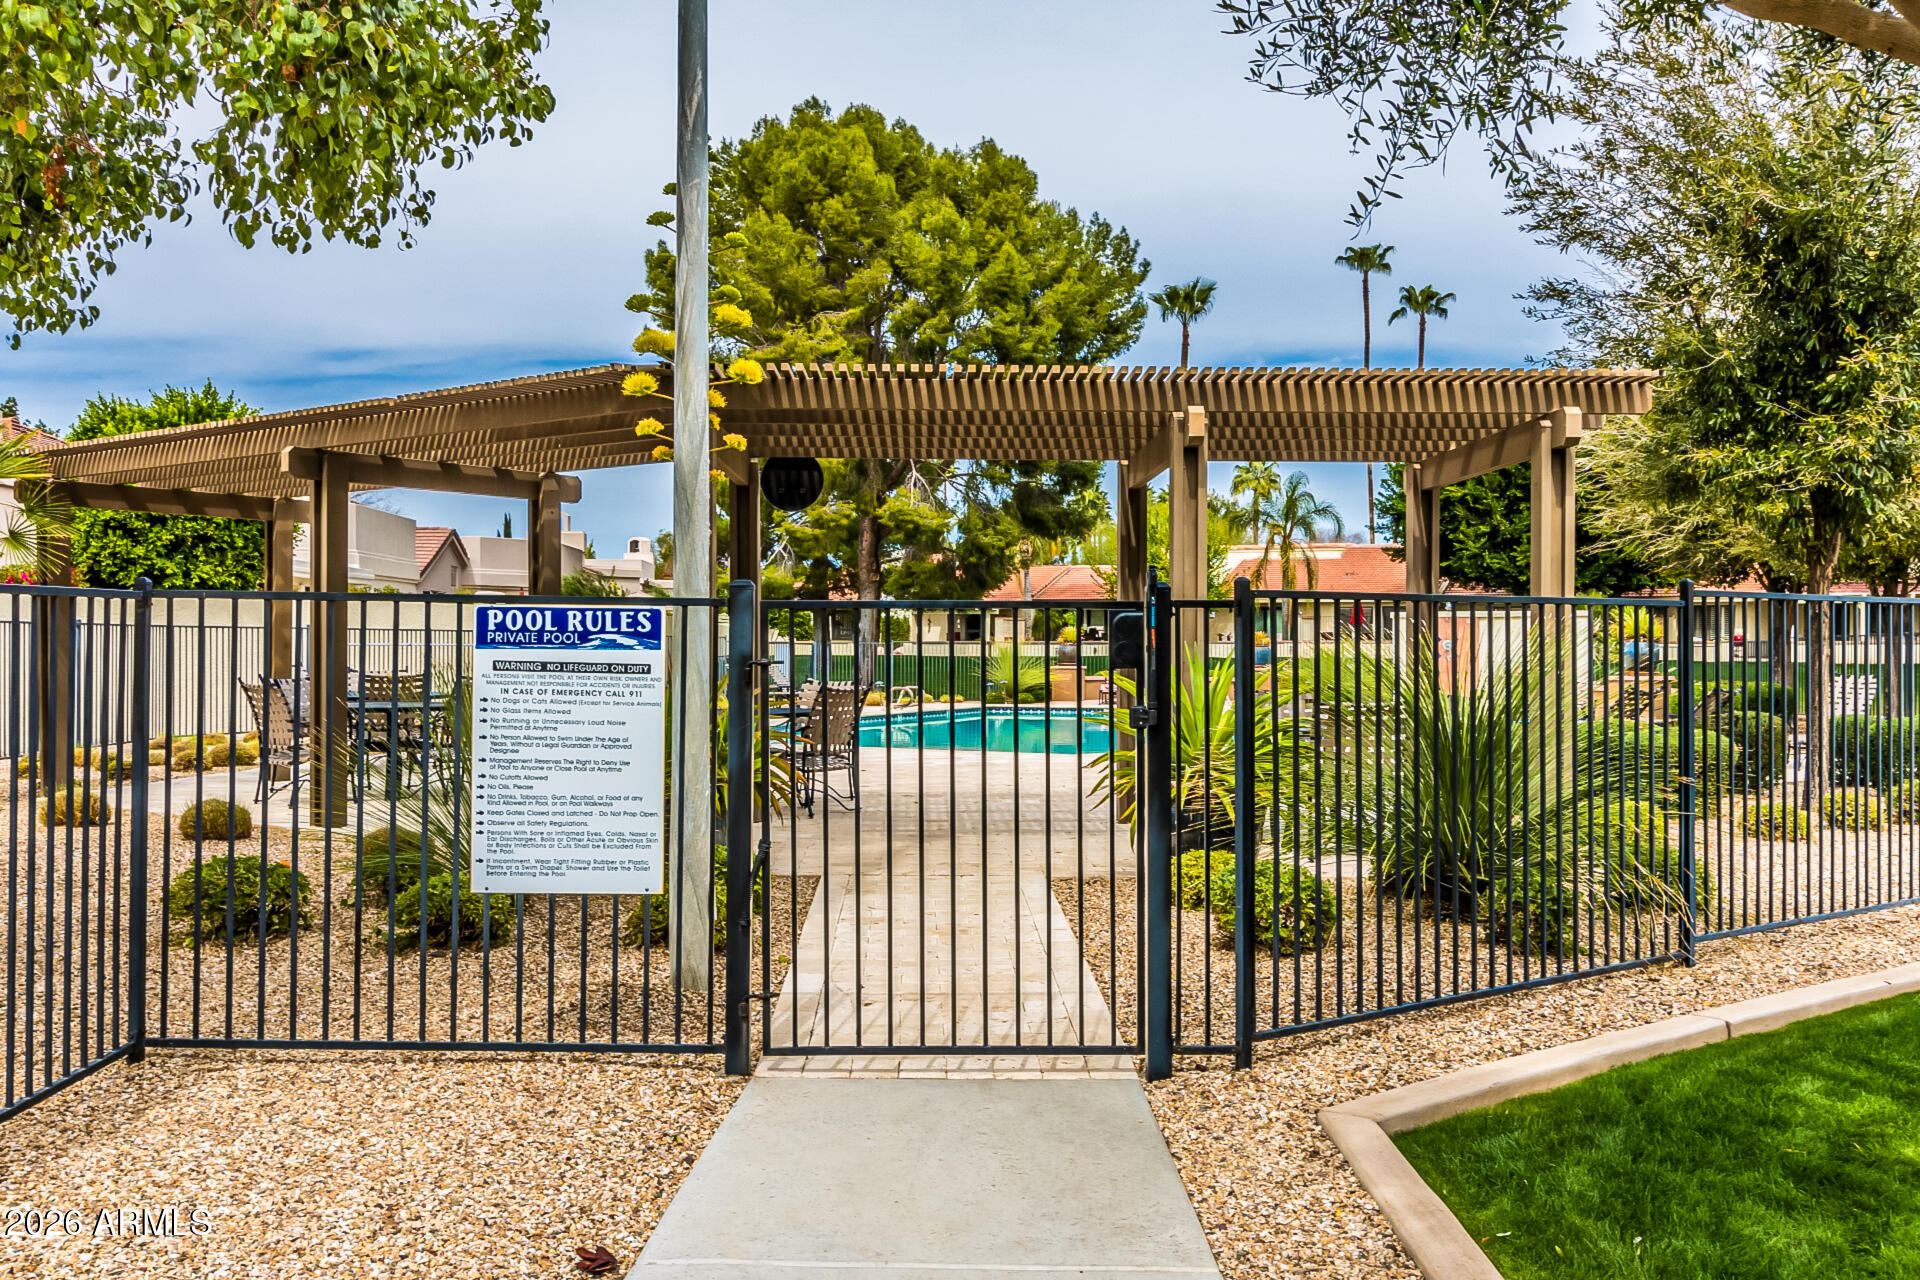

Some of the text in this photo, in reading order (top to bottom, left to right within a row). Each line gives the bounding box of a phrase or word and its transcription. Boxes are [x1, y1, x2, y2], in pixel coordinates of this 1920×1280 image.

[487, 609, 652, 632] POOL RULES
[487, 632, 581, 644] PRIVATE POOL
[495, 662, 542, 671] WARNING
[563, 663, 608, 672] LIFEGUARD
[628, 665, 649, 673] DUTY
[503, 697, 520, 705] Dogs
[542, 718, 585, 726] Unnecessary
